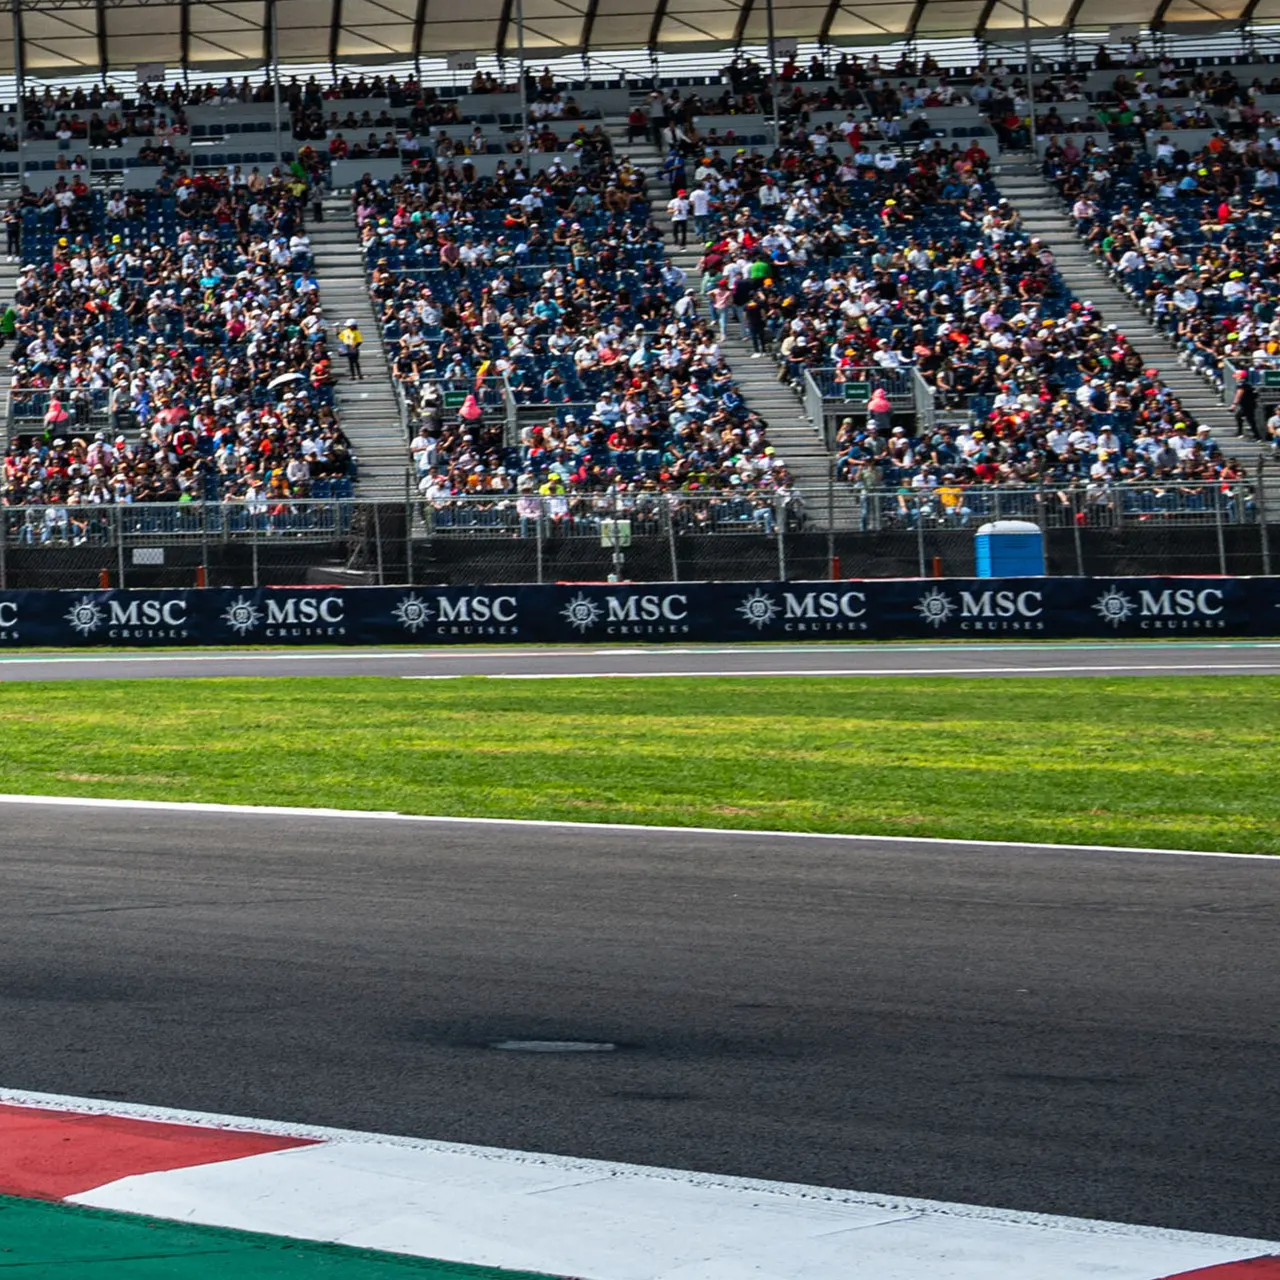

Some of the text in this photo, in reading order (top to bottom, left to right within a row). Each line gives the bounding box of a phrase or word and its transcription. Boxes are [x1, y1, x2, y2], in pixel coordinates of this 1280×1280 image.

[264, 596, 344, 624] MSC
[436, 596, 517, 622] MSC
[606, 594, 688, 622] MSC
[783, 591, 866, 618] MSC
[960, 590, 1043, 617] MSC
[1140, 588, 1223, 616] MSC
[108, 599, 187, 626] MSC
[265, 626, 346, 637] CRUISES
[437, 625, 518, 634] CRUISES
[607, 624, 689, 634] CRUISES
[784, 621, 867, 631] CRUISES
[961, 621, 1043, 629] CRUISES
[1141, 619, 1224, 628] CRUISES
[109, 628, 187, 638] CRUISES
